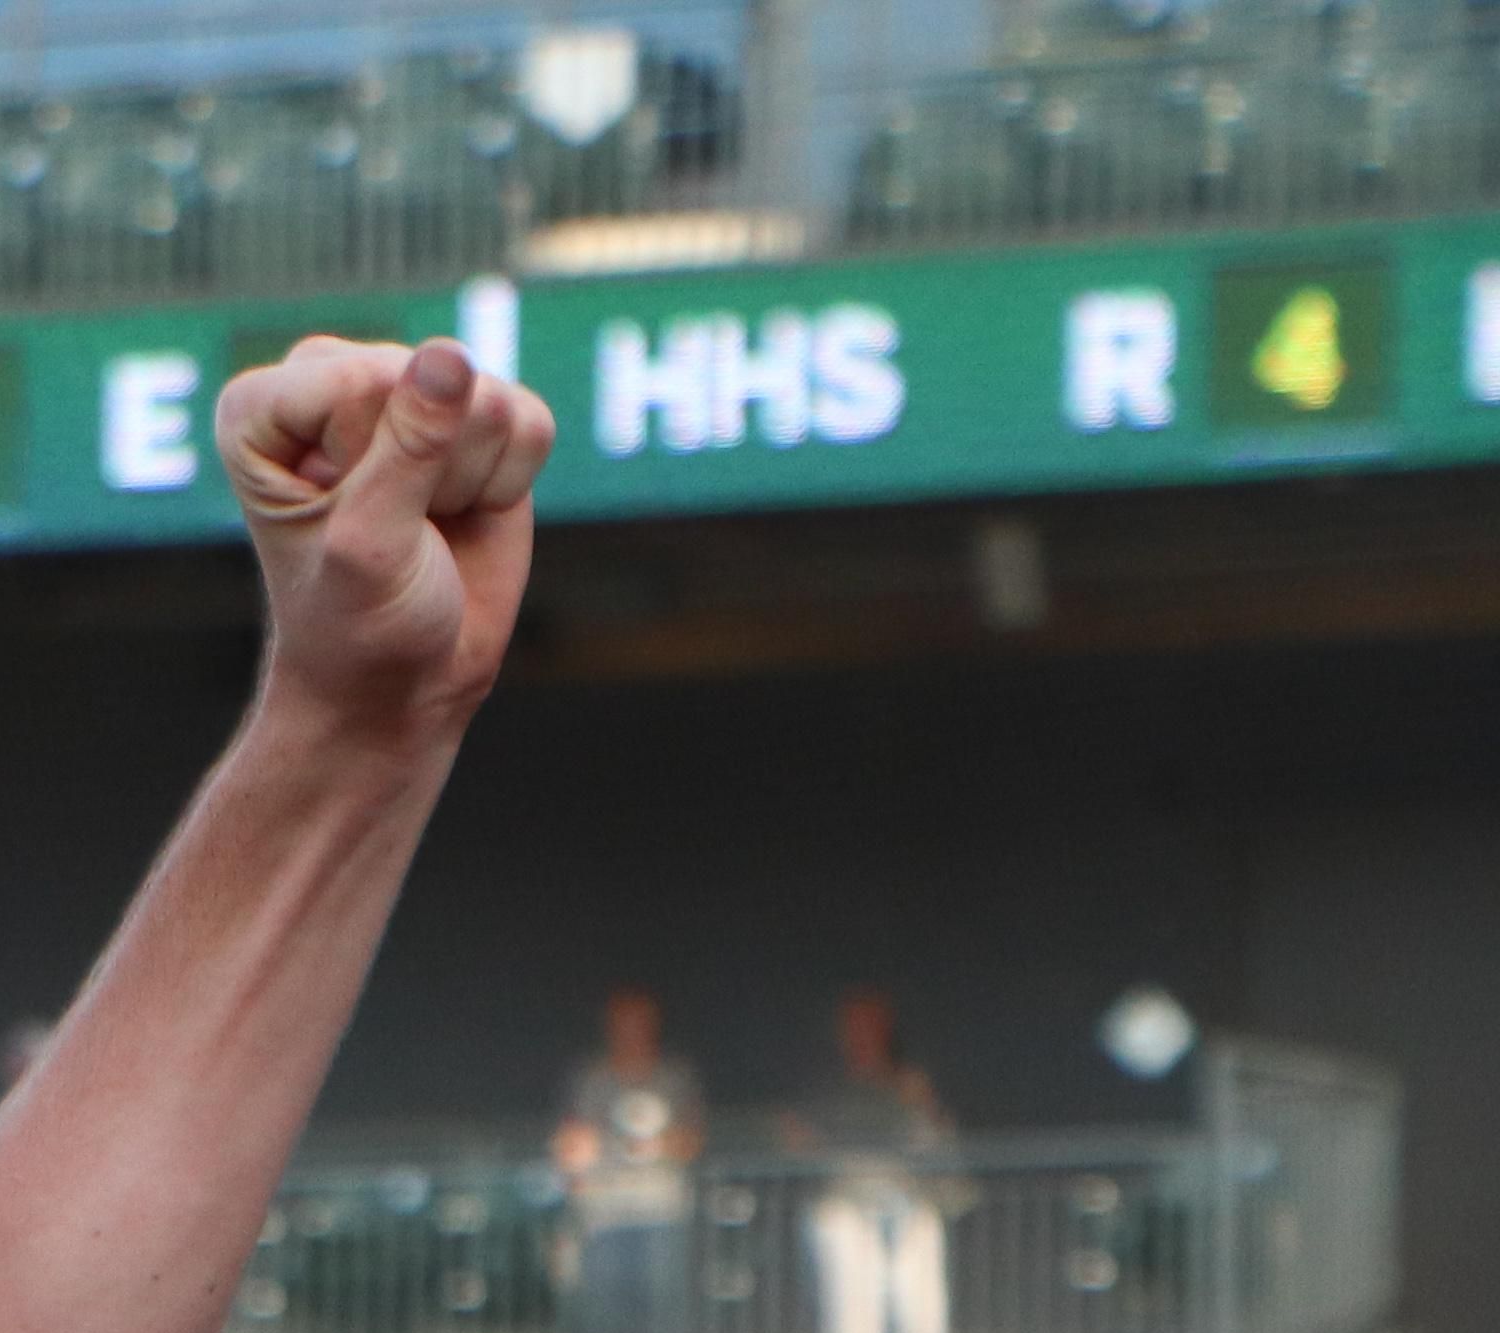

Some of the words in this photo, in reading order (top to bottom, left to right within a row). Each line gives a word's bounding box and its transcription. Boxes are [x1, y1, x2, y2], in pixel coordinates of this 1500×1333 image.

[102, 351, 200, 490] E
[594, 300, 905, 457] HHS
[1063, 286, 1177, 430] R
[1251, 287, 1347, 410] 4
